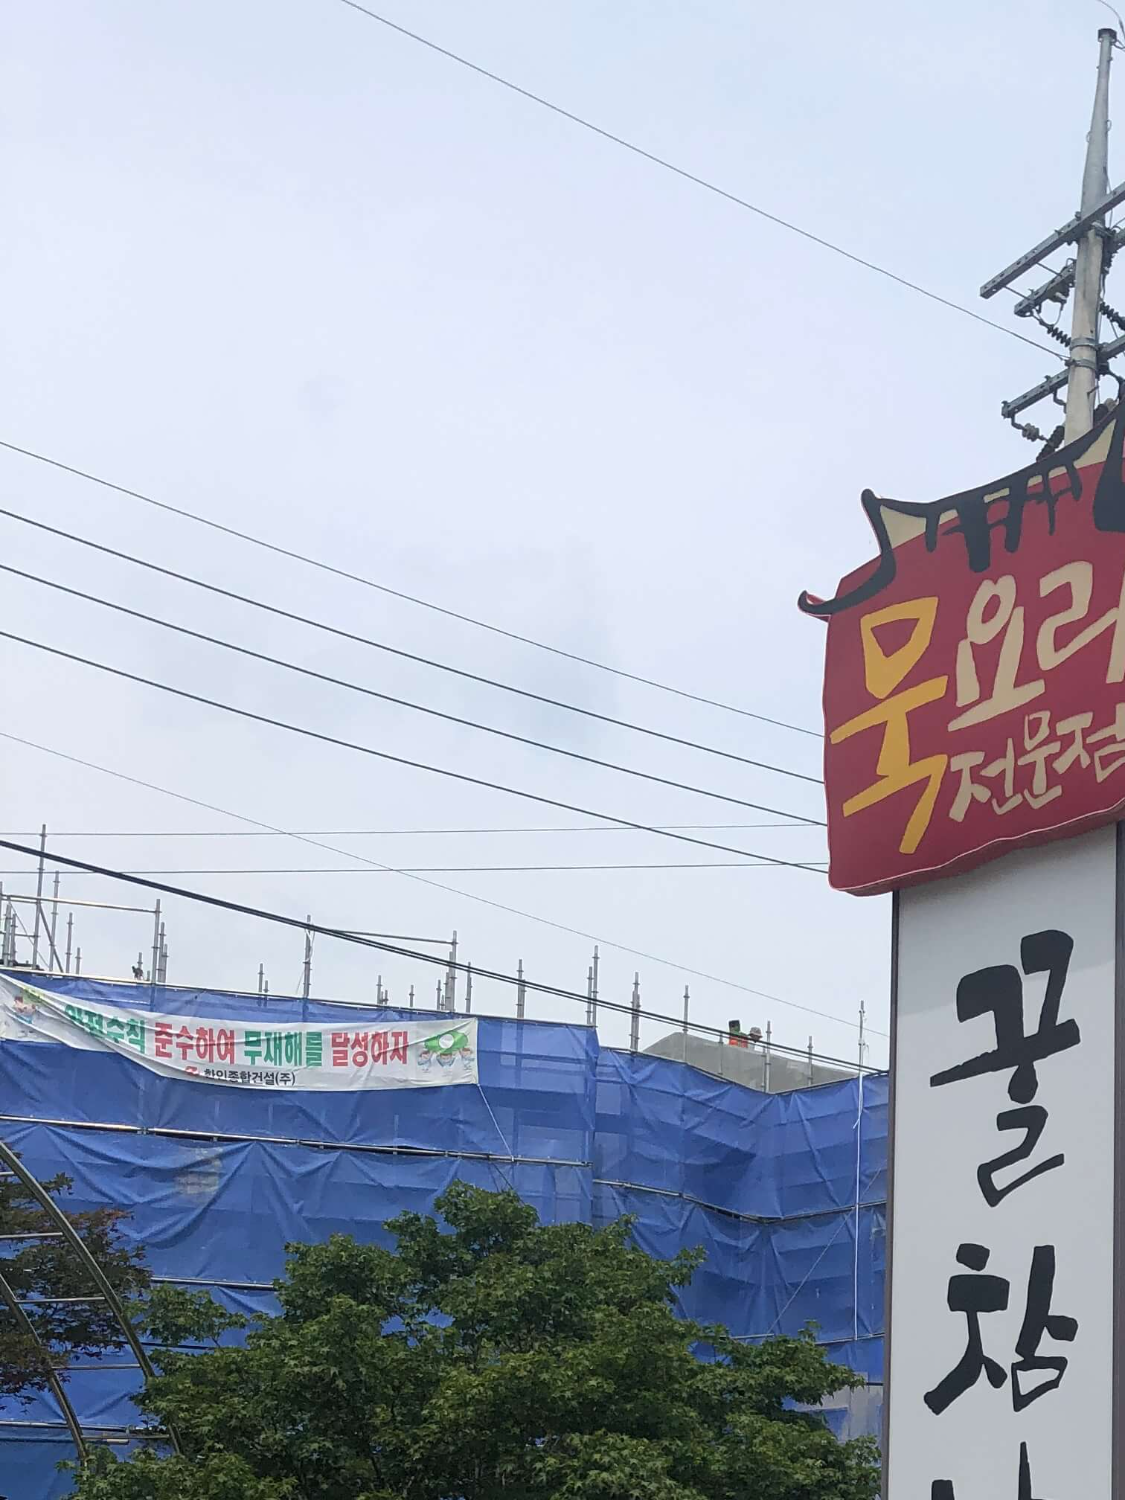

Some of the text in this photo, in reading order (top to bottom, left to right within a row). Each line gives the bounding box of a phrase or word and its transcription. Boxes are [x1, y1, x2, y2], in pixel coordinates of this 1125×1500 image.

[831, 597, 947, 854] 묵
[154, 1022, 235, 1065] 준수하여
[244, 1030, 323, 1067] 무재해를
[331, 1031, 409, 1068] 달성하자
